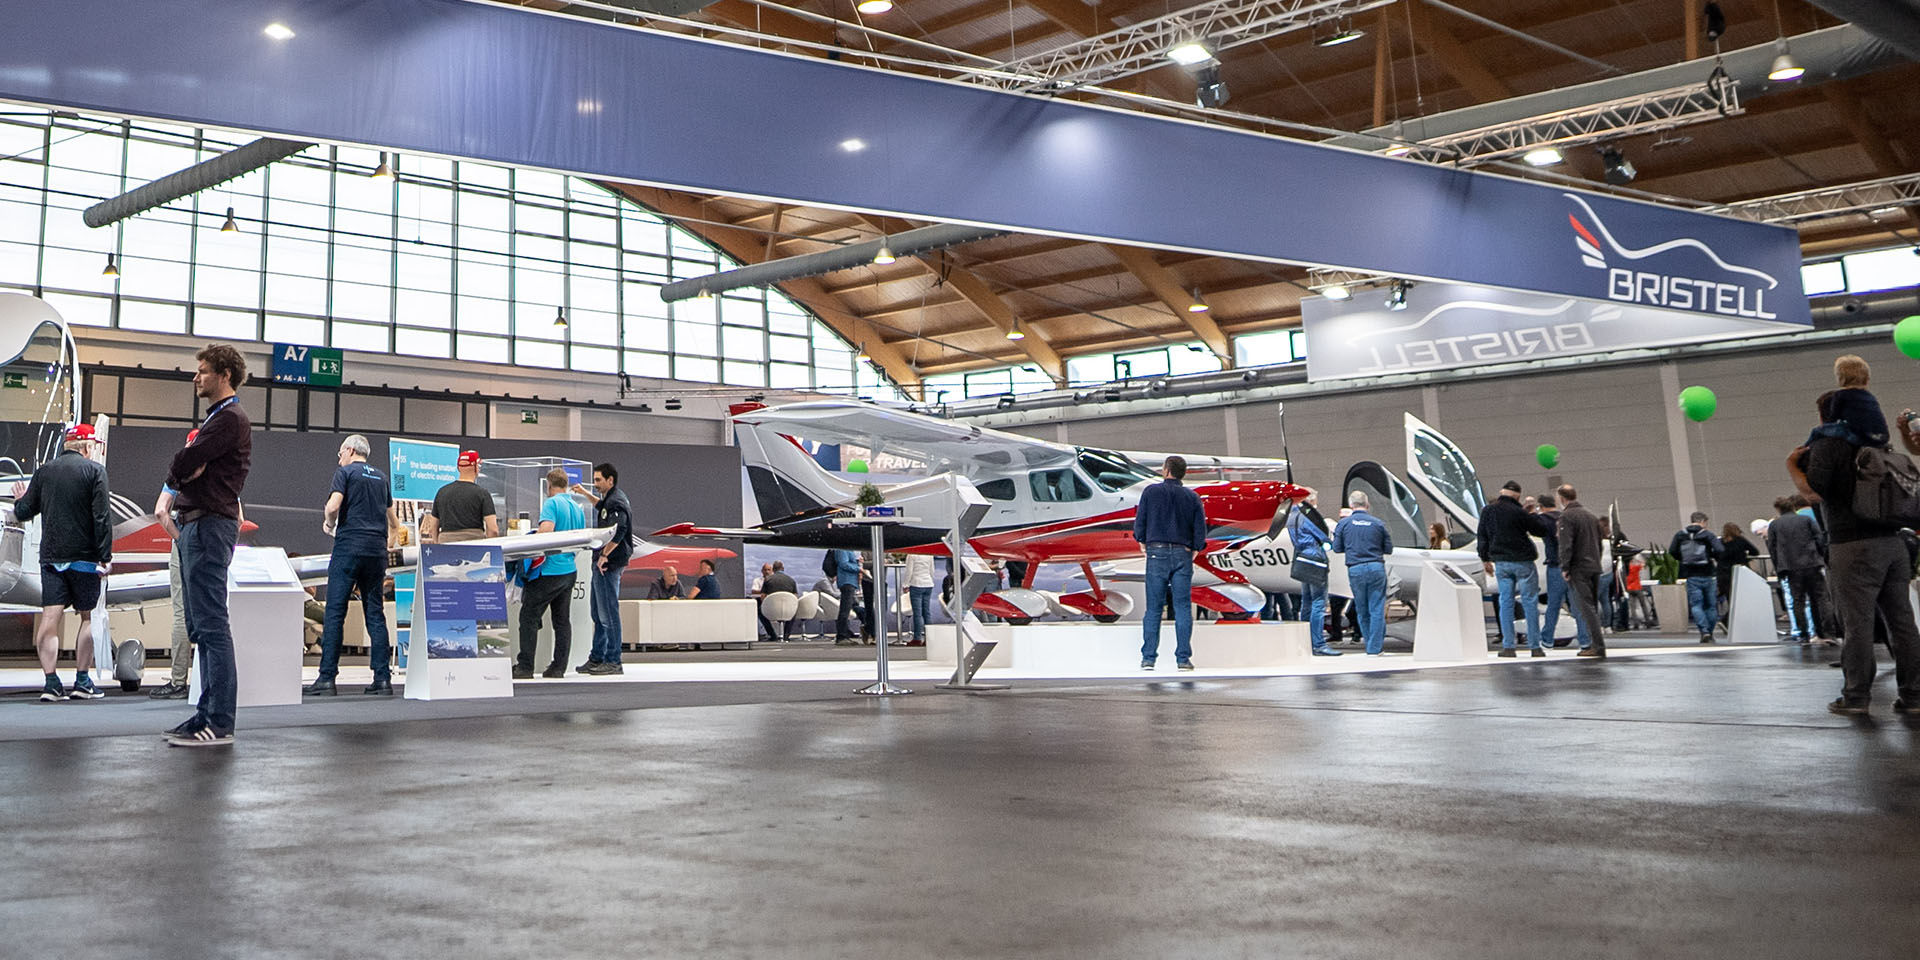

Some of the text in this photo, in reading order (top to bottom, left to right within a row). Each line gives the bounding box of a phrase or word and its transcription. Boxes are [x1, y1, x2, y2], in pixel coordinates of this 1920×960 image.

[1608, 268, 1776, 319] BRISTELL
[284, 345, 308, 361] A7
[417, 472, 436, 480] electric
